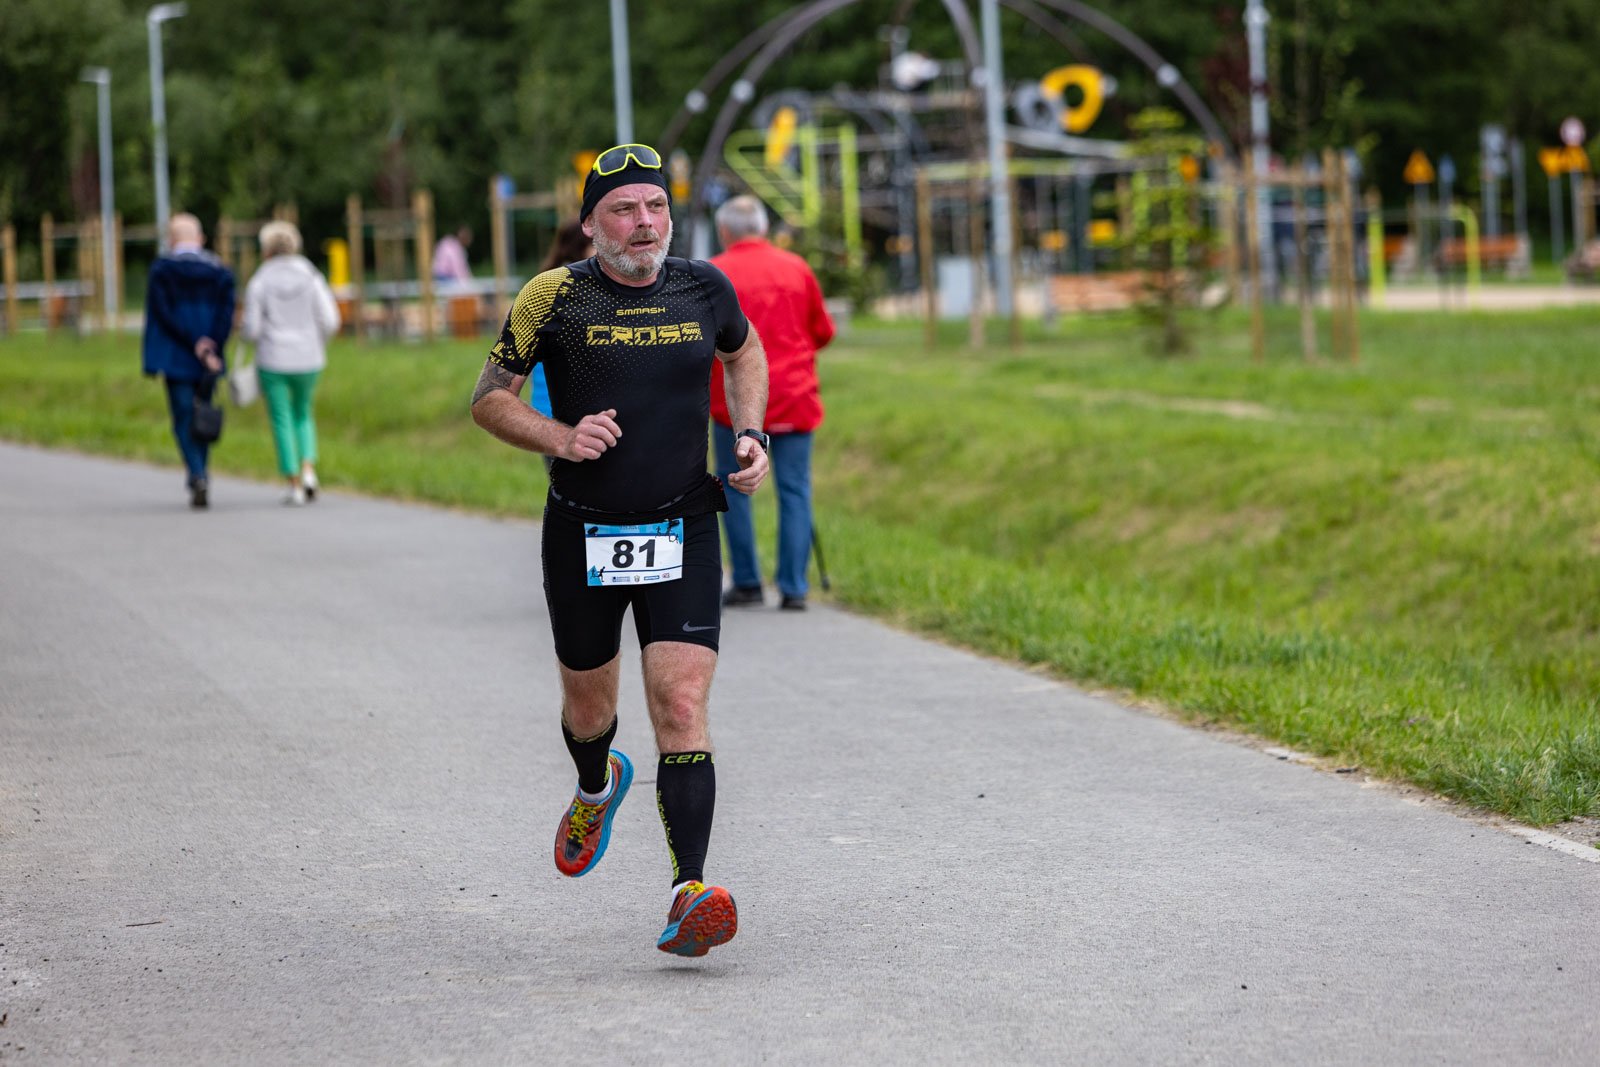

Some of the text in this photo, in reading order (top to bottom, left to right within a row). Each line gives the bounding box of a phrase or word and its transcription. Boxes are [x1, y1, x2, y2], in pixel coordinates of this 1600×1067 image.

[616, 306, 666, 316] SMMASH
[586, 321, 703, 346] CROSS
[611, 538, 656, 569] 81
